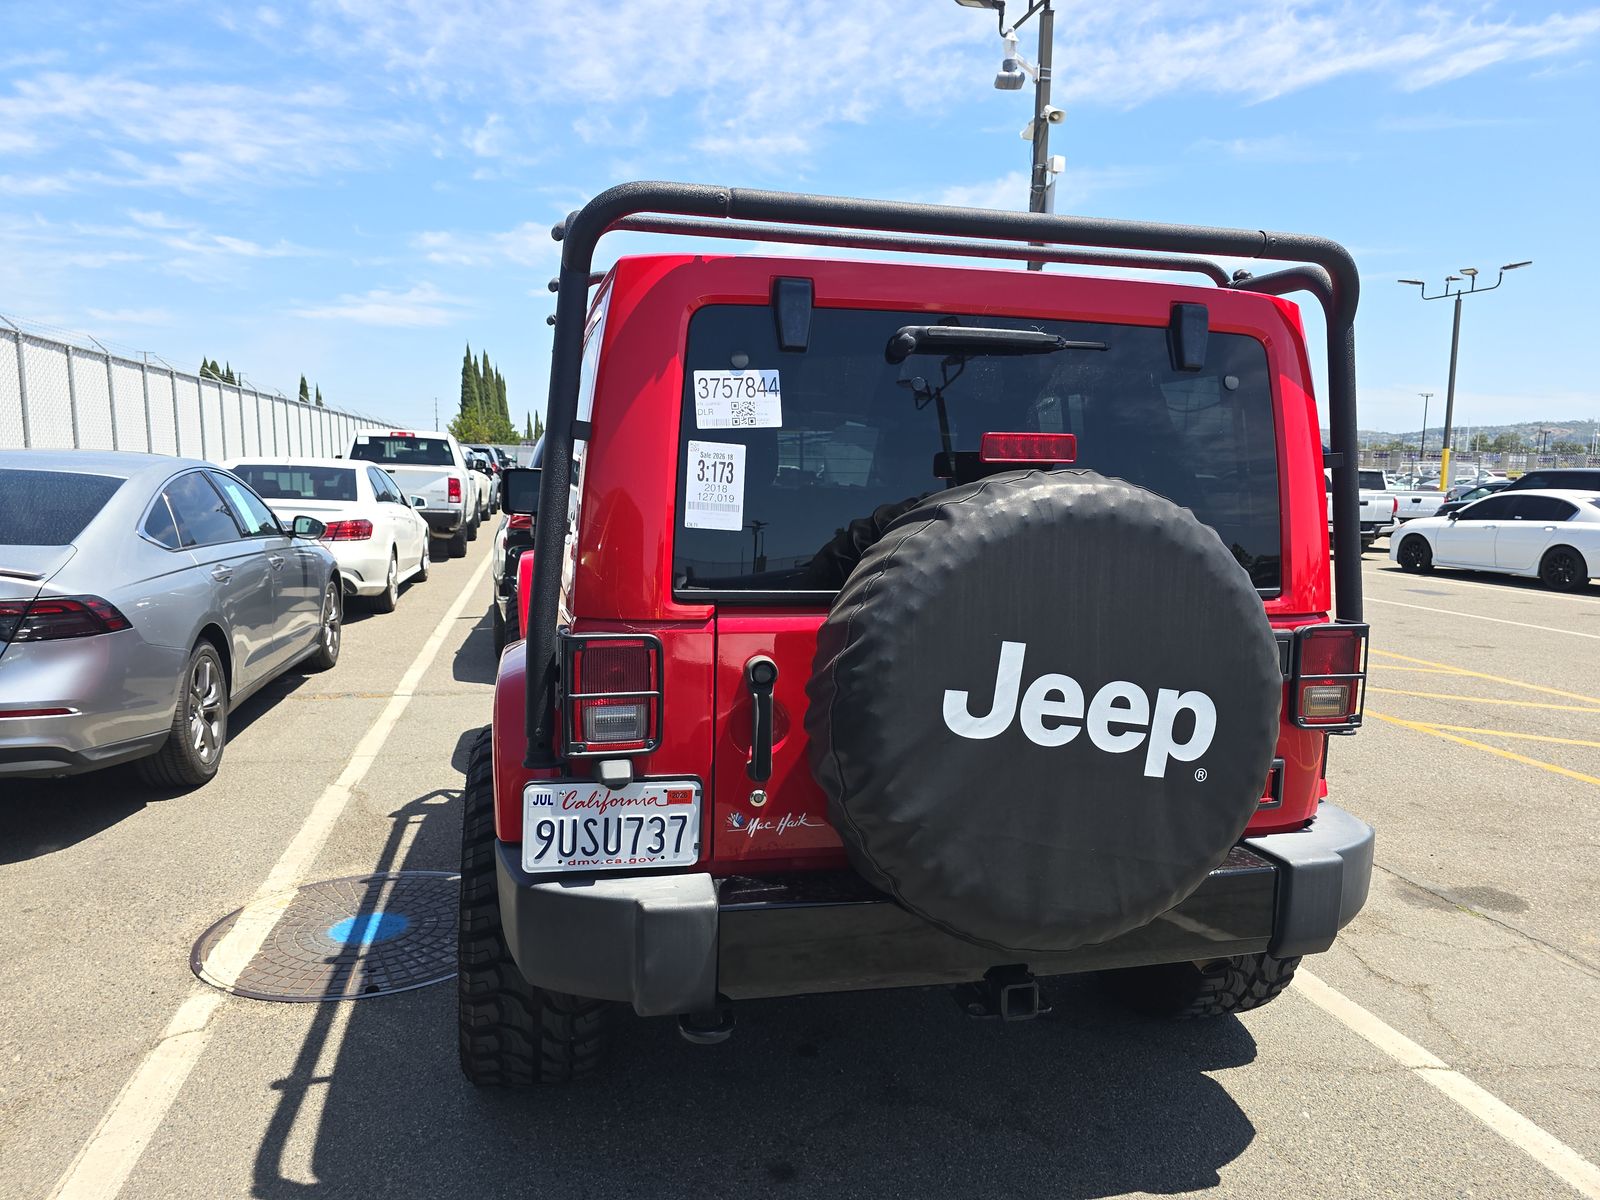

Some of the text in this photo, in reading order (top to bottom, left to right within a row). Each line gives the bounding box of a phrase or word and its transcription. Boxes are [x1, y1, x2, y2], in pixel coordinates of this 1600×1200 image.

[698, 377, 779, 399] 3757844
[697, 460, 734, 484] 3:173
[697, 493, 735, 503] 127,019
[704, 484, 728, 493] 2018
[942, 640, 1217, 778] Jeep
[532, 794, 554, 806] JUL
[562, 790, 668, 815] California
[736, 812, 816, 838] Mac Haik
[534, 815, 688, 861] 9USU737
[567, 856, 656, 867] dmv.ca.gov
